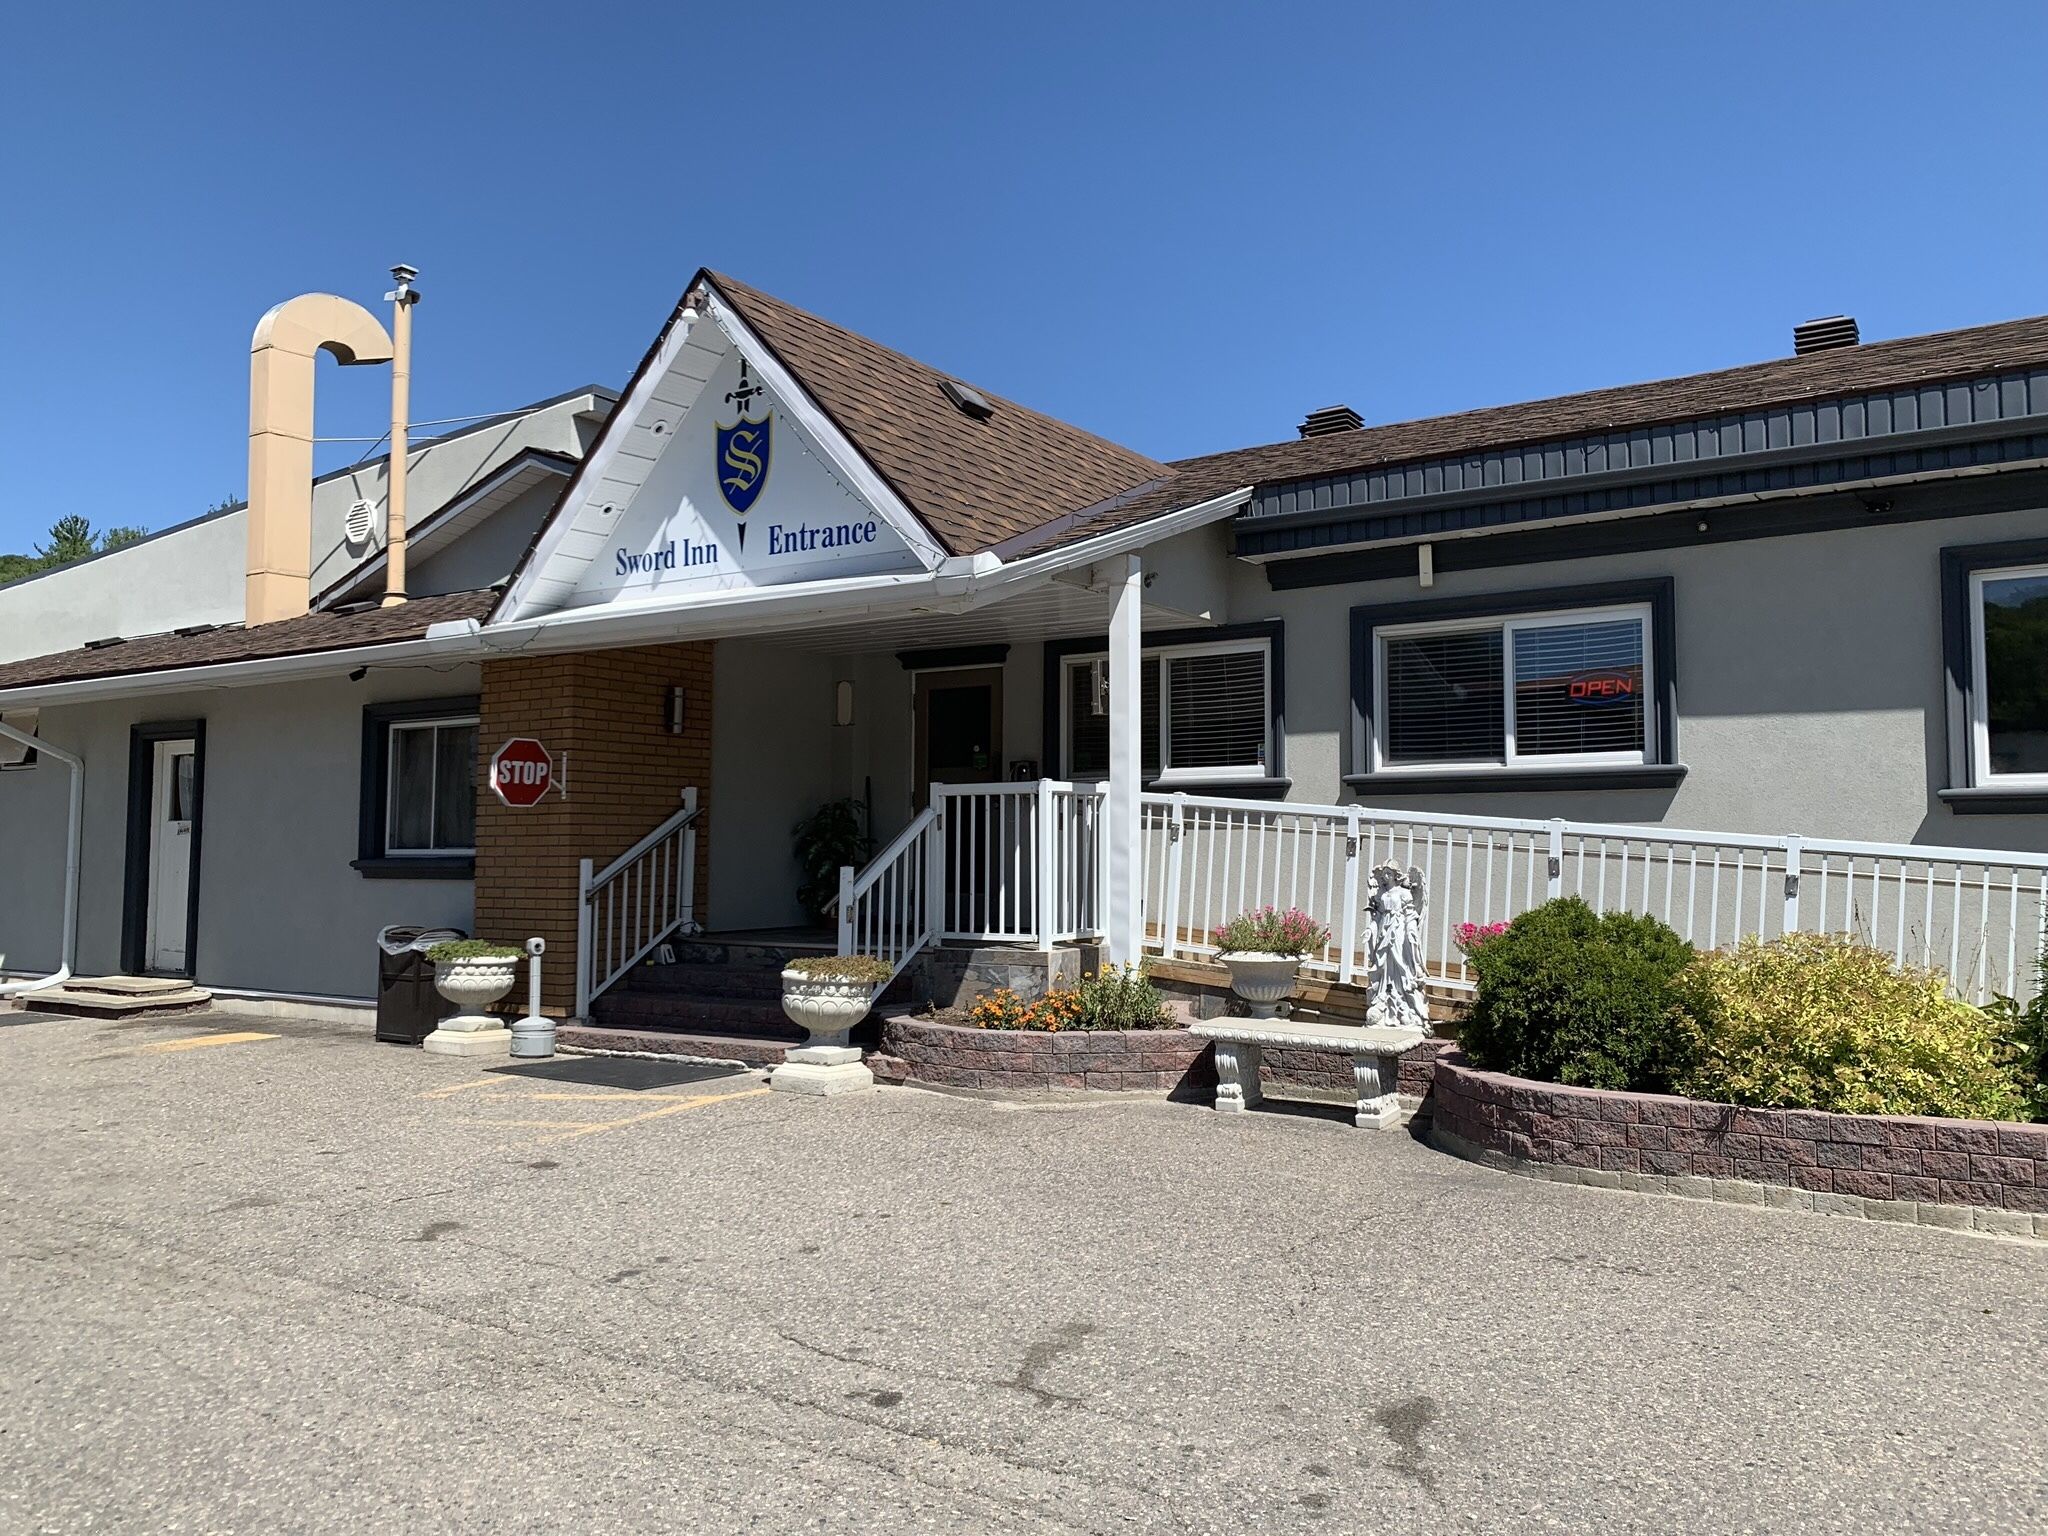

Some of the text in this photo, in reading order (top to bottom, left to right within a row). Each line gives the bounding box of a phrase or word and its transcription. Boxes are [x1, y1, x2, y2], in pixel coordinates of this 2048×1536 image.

[768, 519, 877, 555] Entrance
[615, 538, 718, 576] Sword Inn
[1570, 678, 1632, 697] OPEN
[499, 760, 548, 785] STOP
